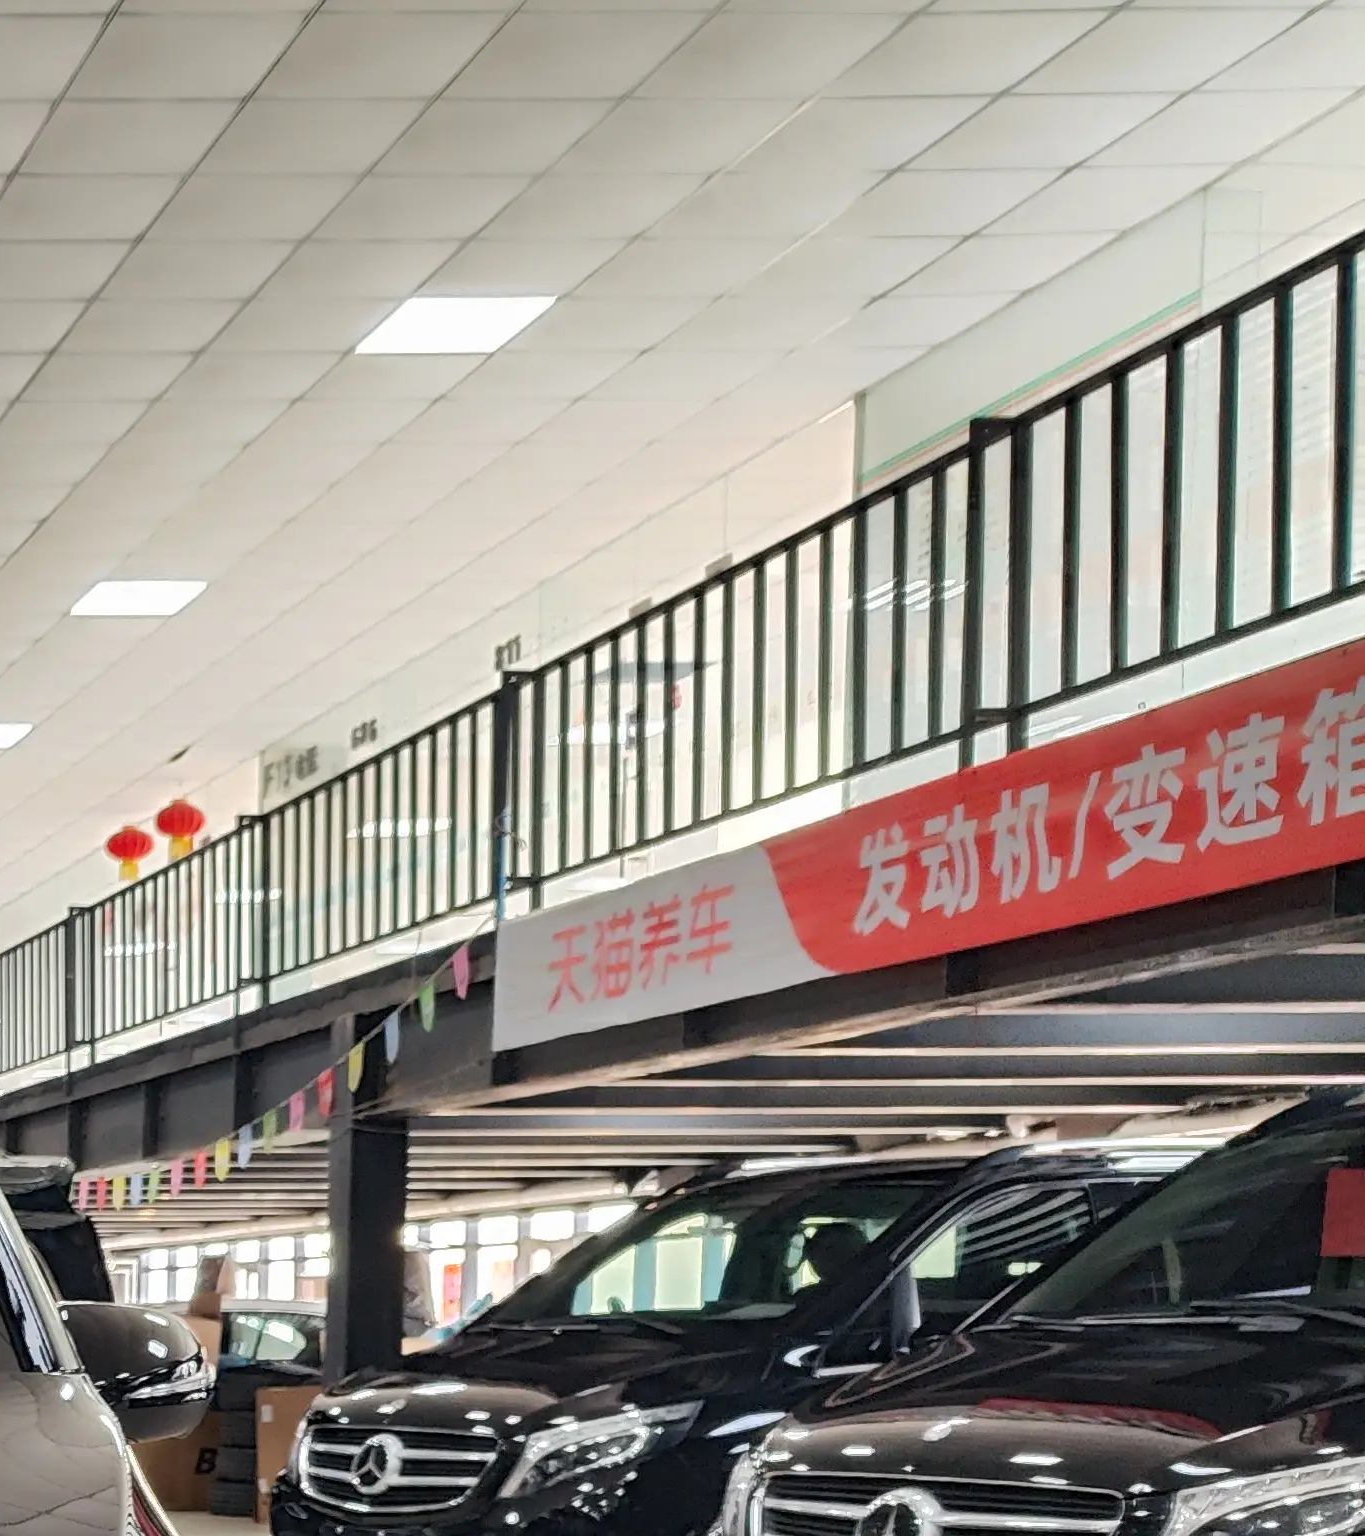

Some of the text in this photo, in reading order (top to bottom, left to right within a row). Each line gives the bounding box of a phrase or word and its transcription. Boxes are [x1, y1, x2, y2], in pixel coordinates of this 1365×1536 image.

[853, 674, 1365, 935] 发动机/变速箱
[548, 883, 736, 1012] 天猫养车
